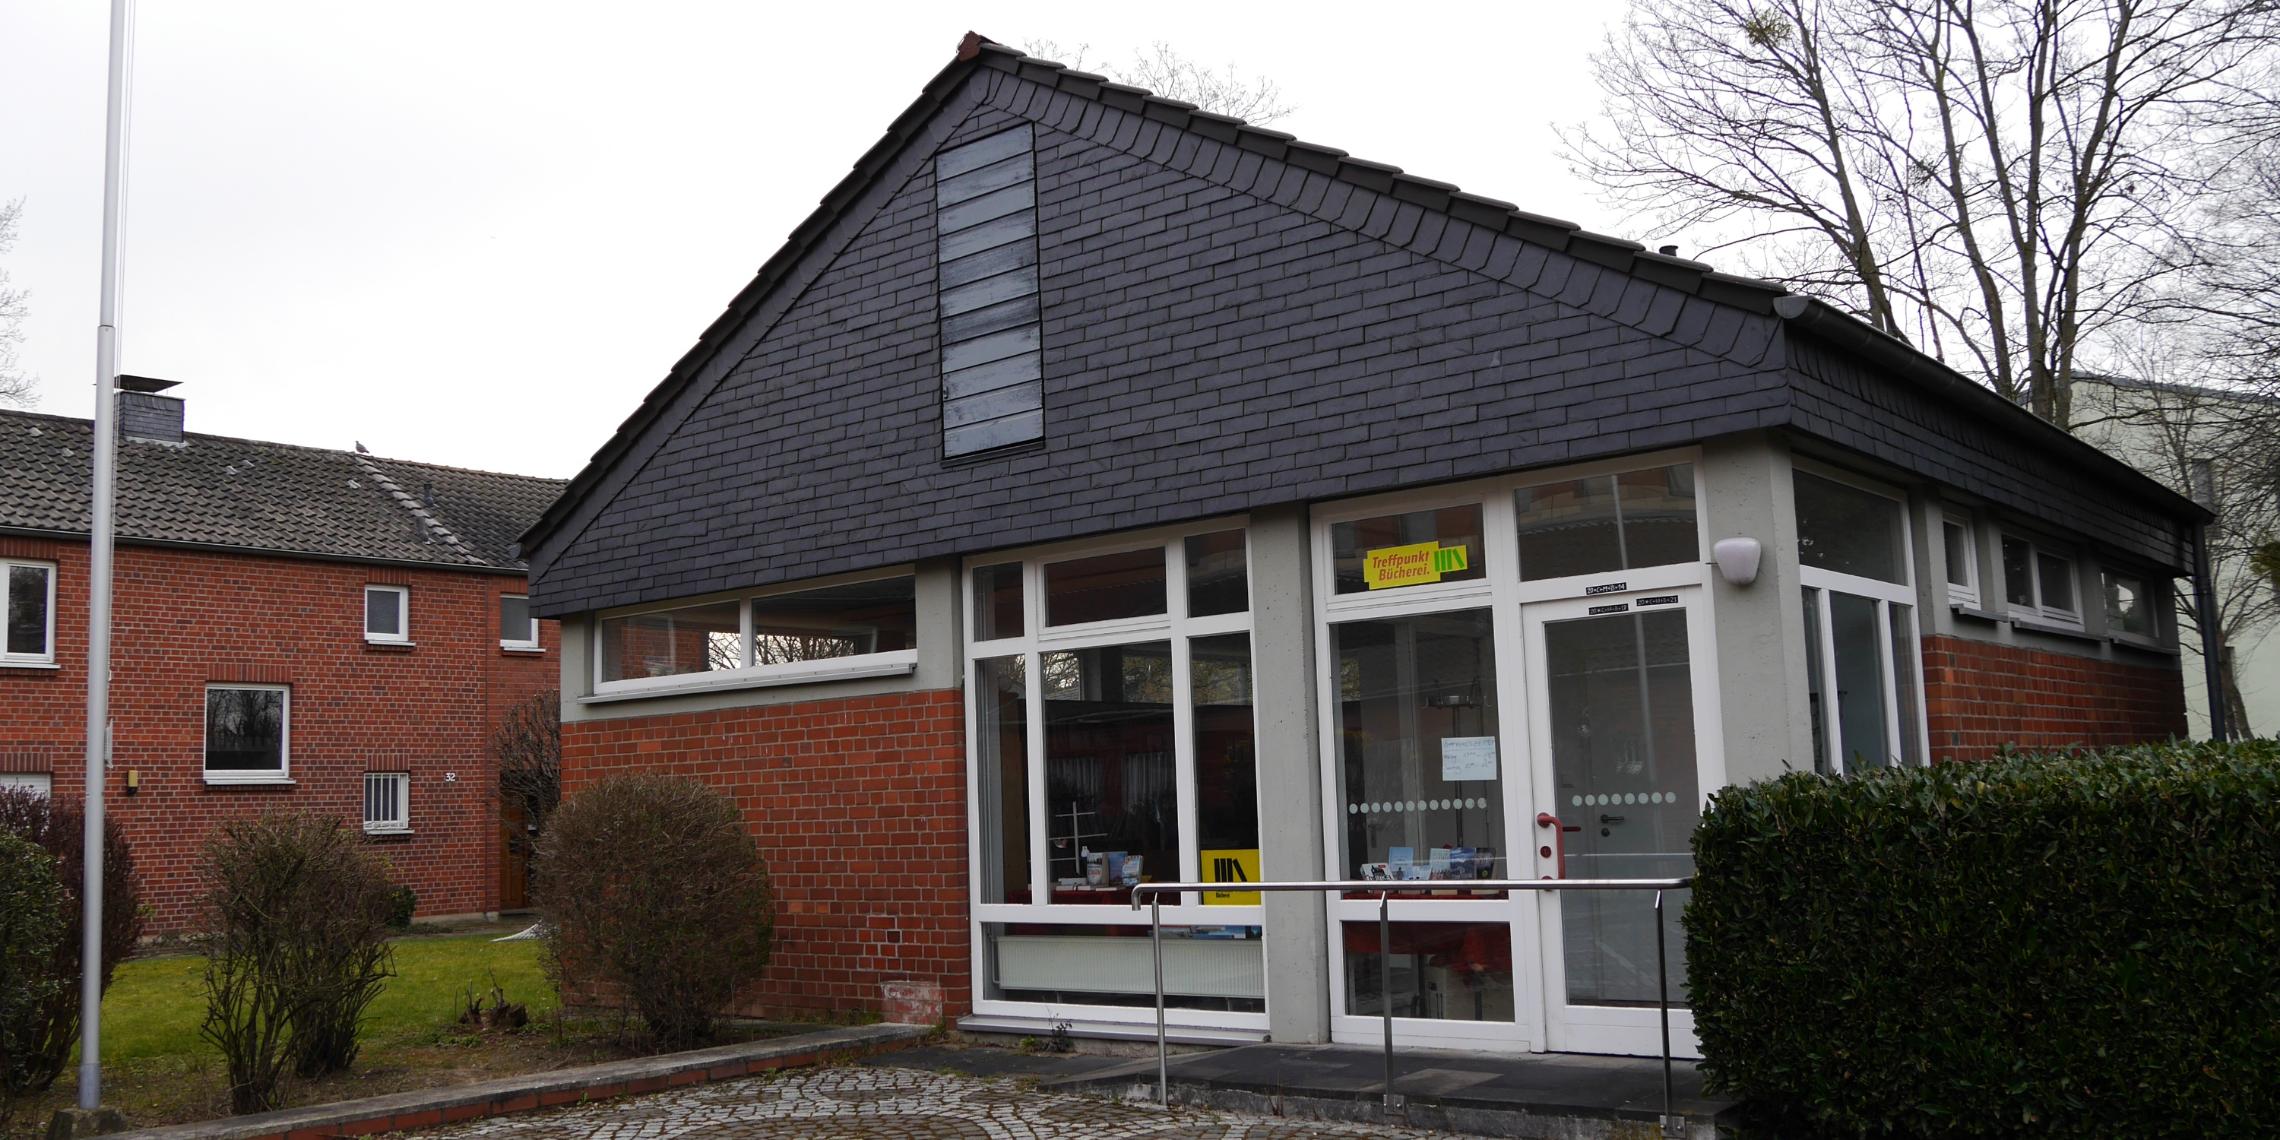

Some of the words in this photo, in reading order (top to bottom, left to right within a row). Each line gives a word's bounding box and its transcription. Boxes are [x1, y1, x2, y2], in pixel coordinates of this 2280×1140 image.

[1373, 550, 1430, 569] Treffpunkt
[1378, 563, 1430, 581] Bücherei.
[445, 772, 456, 782] 32
